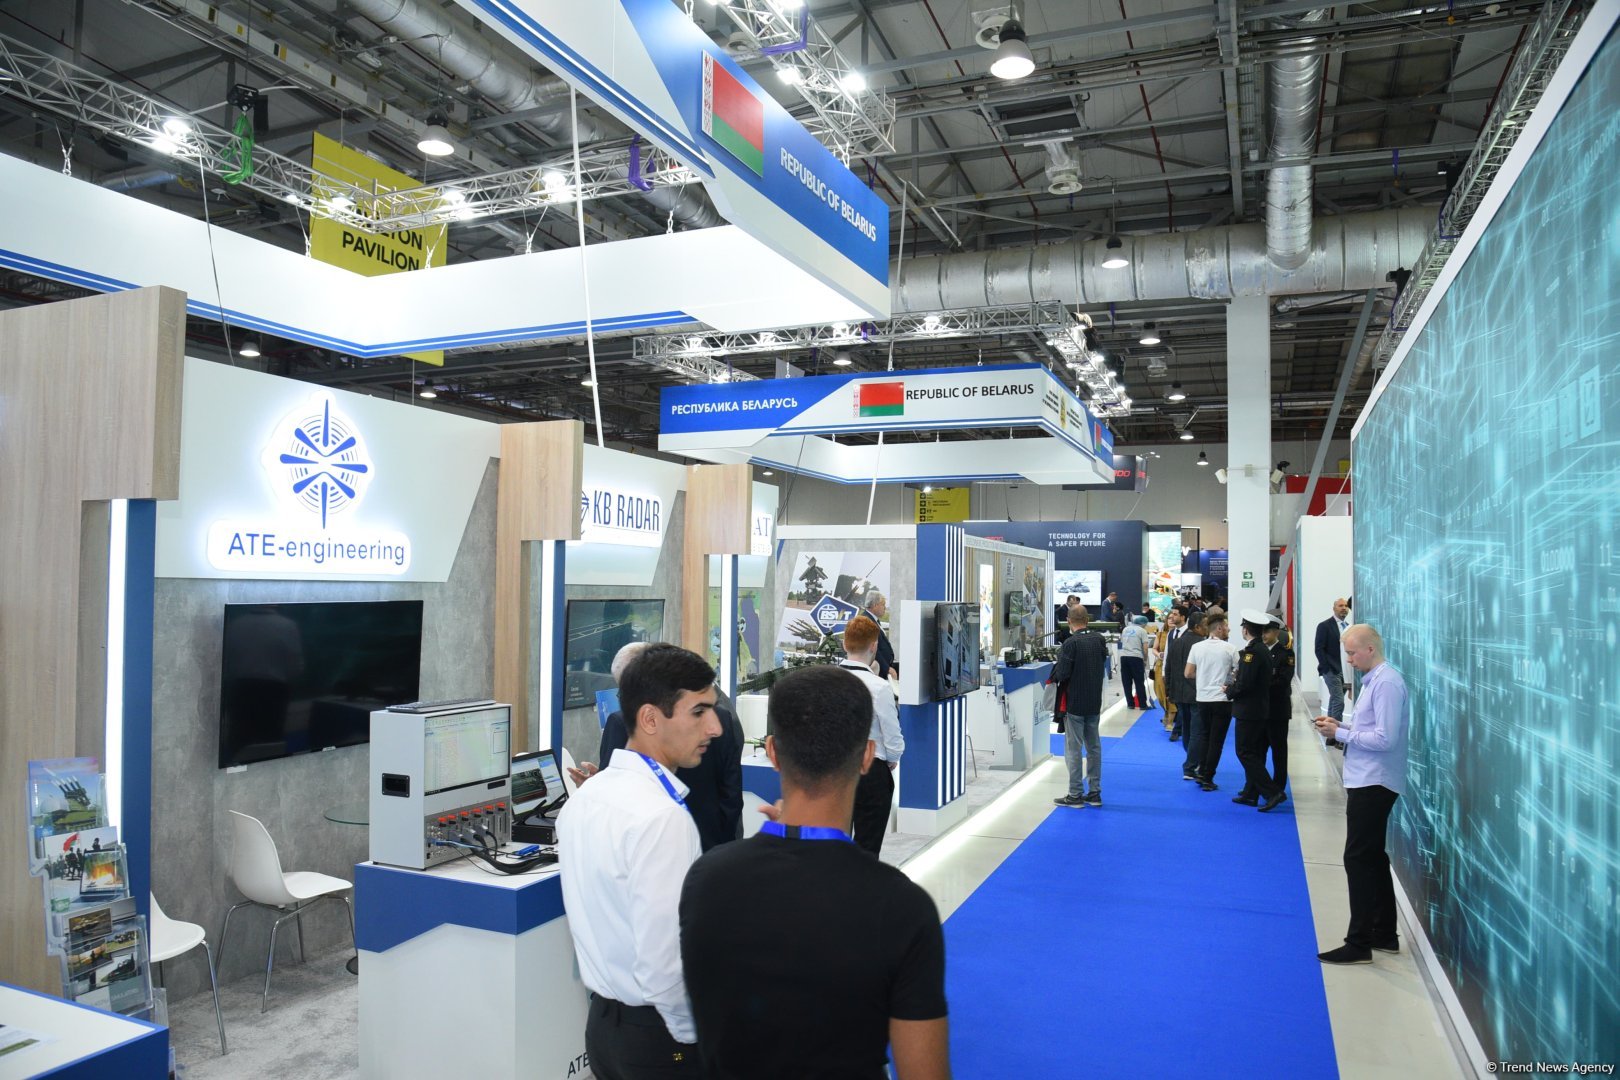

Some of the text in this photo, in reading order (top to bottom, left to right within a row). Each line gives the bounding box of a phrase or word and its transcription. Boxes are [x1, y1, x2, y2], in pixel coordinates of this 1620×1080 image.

[780, 147, 877, 242] REPUBLIC OF BELARUS
[343, 230, 419, 271] PAVILION
[671, 397, 798, 415] РЕСПУБЛИКА БЕЛАРУСЬ
[905, 383, 1034, 401] REPUBLIC OF BELARUS
[593, 489, 660, 532] KB RADAR
[228, 532, 405, 566] ATE-engineering
